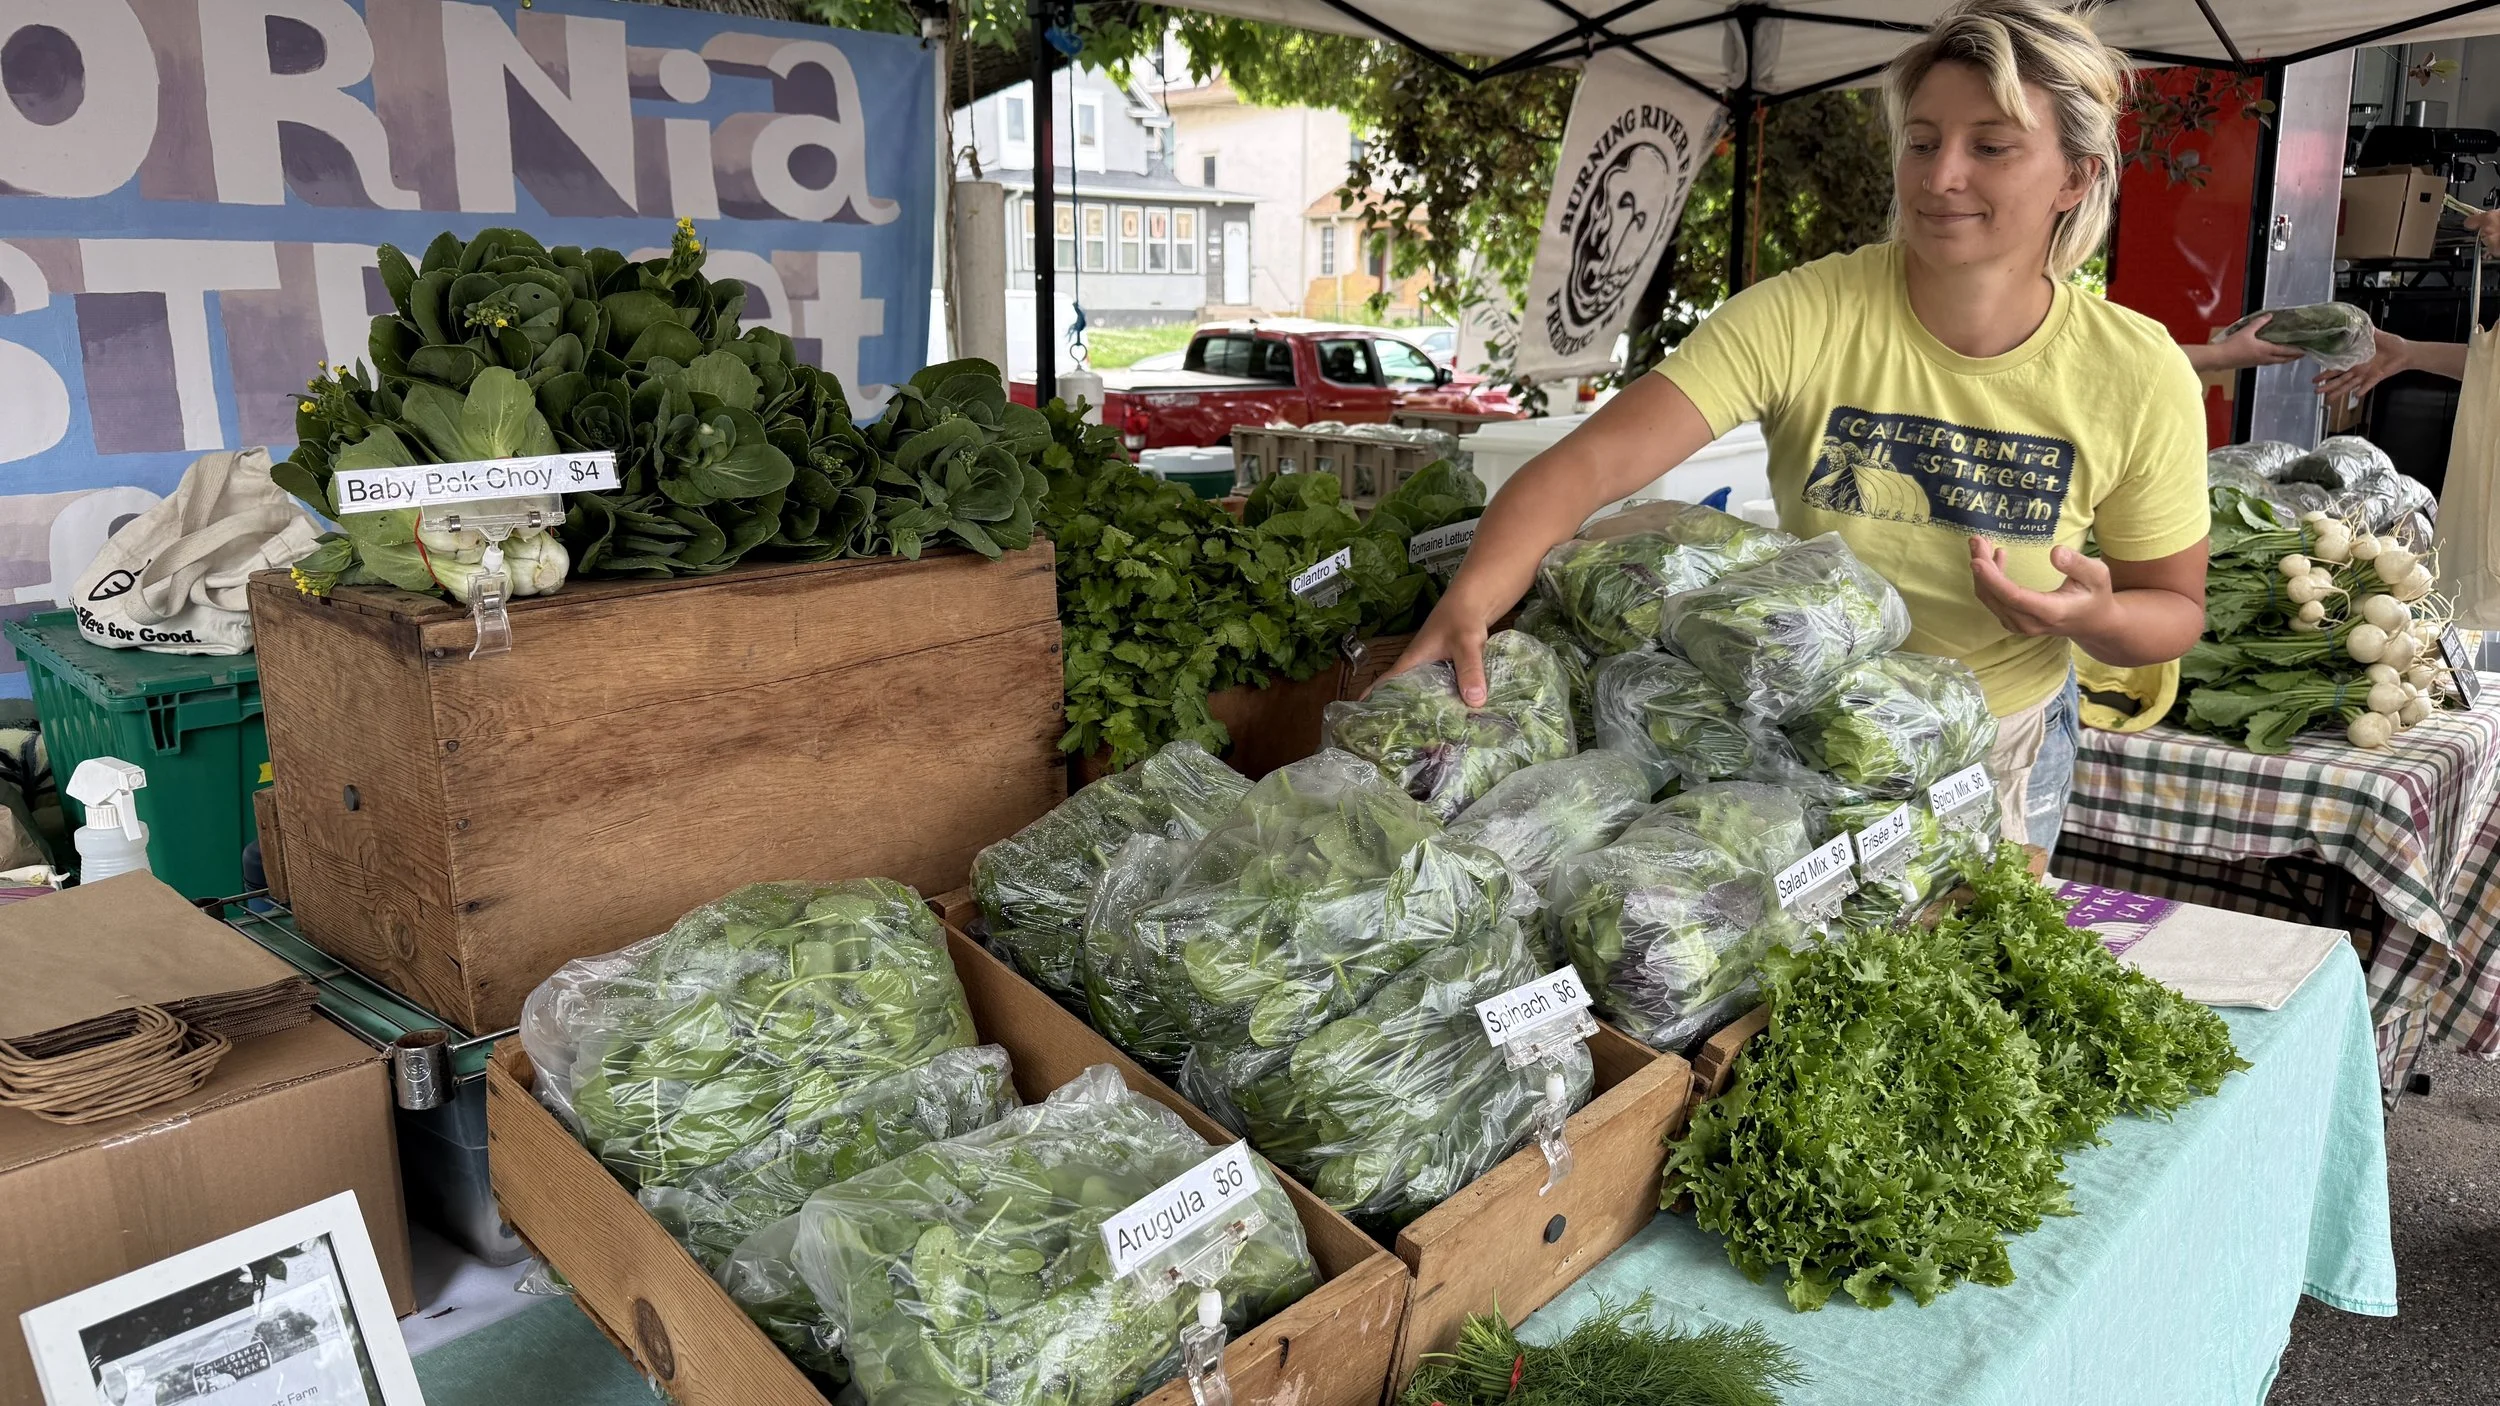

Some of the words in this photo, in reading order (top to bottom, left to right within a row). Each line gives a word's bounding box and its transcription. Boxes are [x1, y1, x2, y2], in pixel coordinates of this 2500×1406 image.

[1560, 107, 1636, 236] BURNING
[1640, 104, 1689, 160] RIVER
[347, 476, 417, 503] Baby
[425, 470, 480, 495] Bok
[485, 466, 553, 490] Choy
[568, 459, 601, 485] $4
[1410, 537, 1443, 557] Romaine
[1445, 529, 1475, 547] Lettuce
[1998, 521, 2014, 531] NE
[2019, 523, 2048, 533] MPLS
[1293, 563, 1330, 593] Cilantro
[1334, 553, 1348, 571] $3
[79, 606, 105, 635] Here
[108, 622, 135, 641] for
[140, 627, 202, 644] Good.
[1932, 788, 1955, 812] Spicy
[1956, 779, 1972, 800] Mix
[1974, 771, 1985, 790] $6
[1862, 825, 1890, 855] Frisée
[1893, 813, 1905, 834] $4
[1778, 864, 1809, 899] Salad
[1808, 854, 1829, 879] Mix
[1831, 842, 1847, 865] $6
[1486, 991, 1551, 1035] Spinach
[1552, 979, 1577, 1005] $6
[1117, 1189, 1206, 1260] Arugula
[1212, 1159, 1243, 1198] $6
[287, 1385, 319, 1405] Farm
